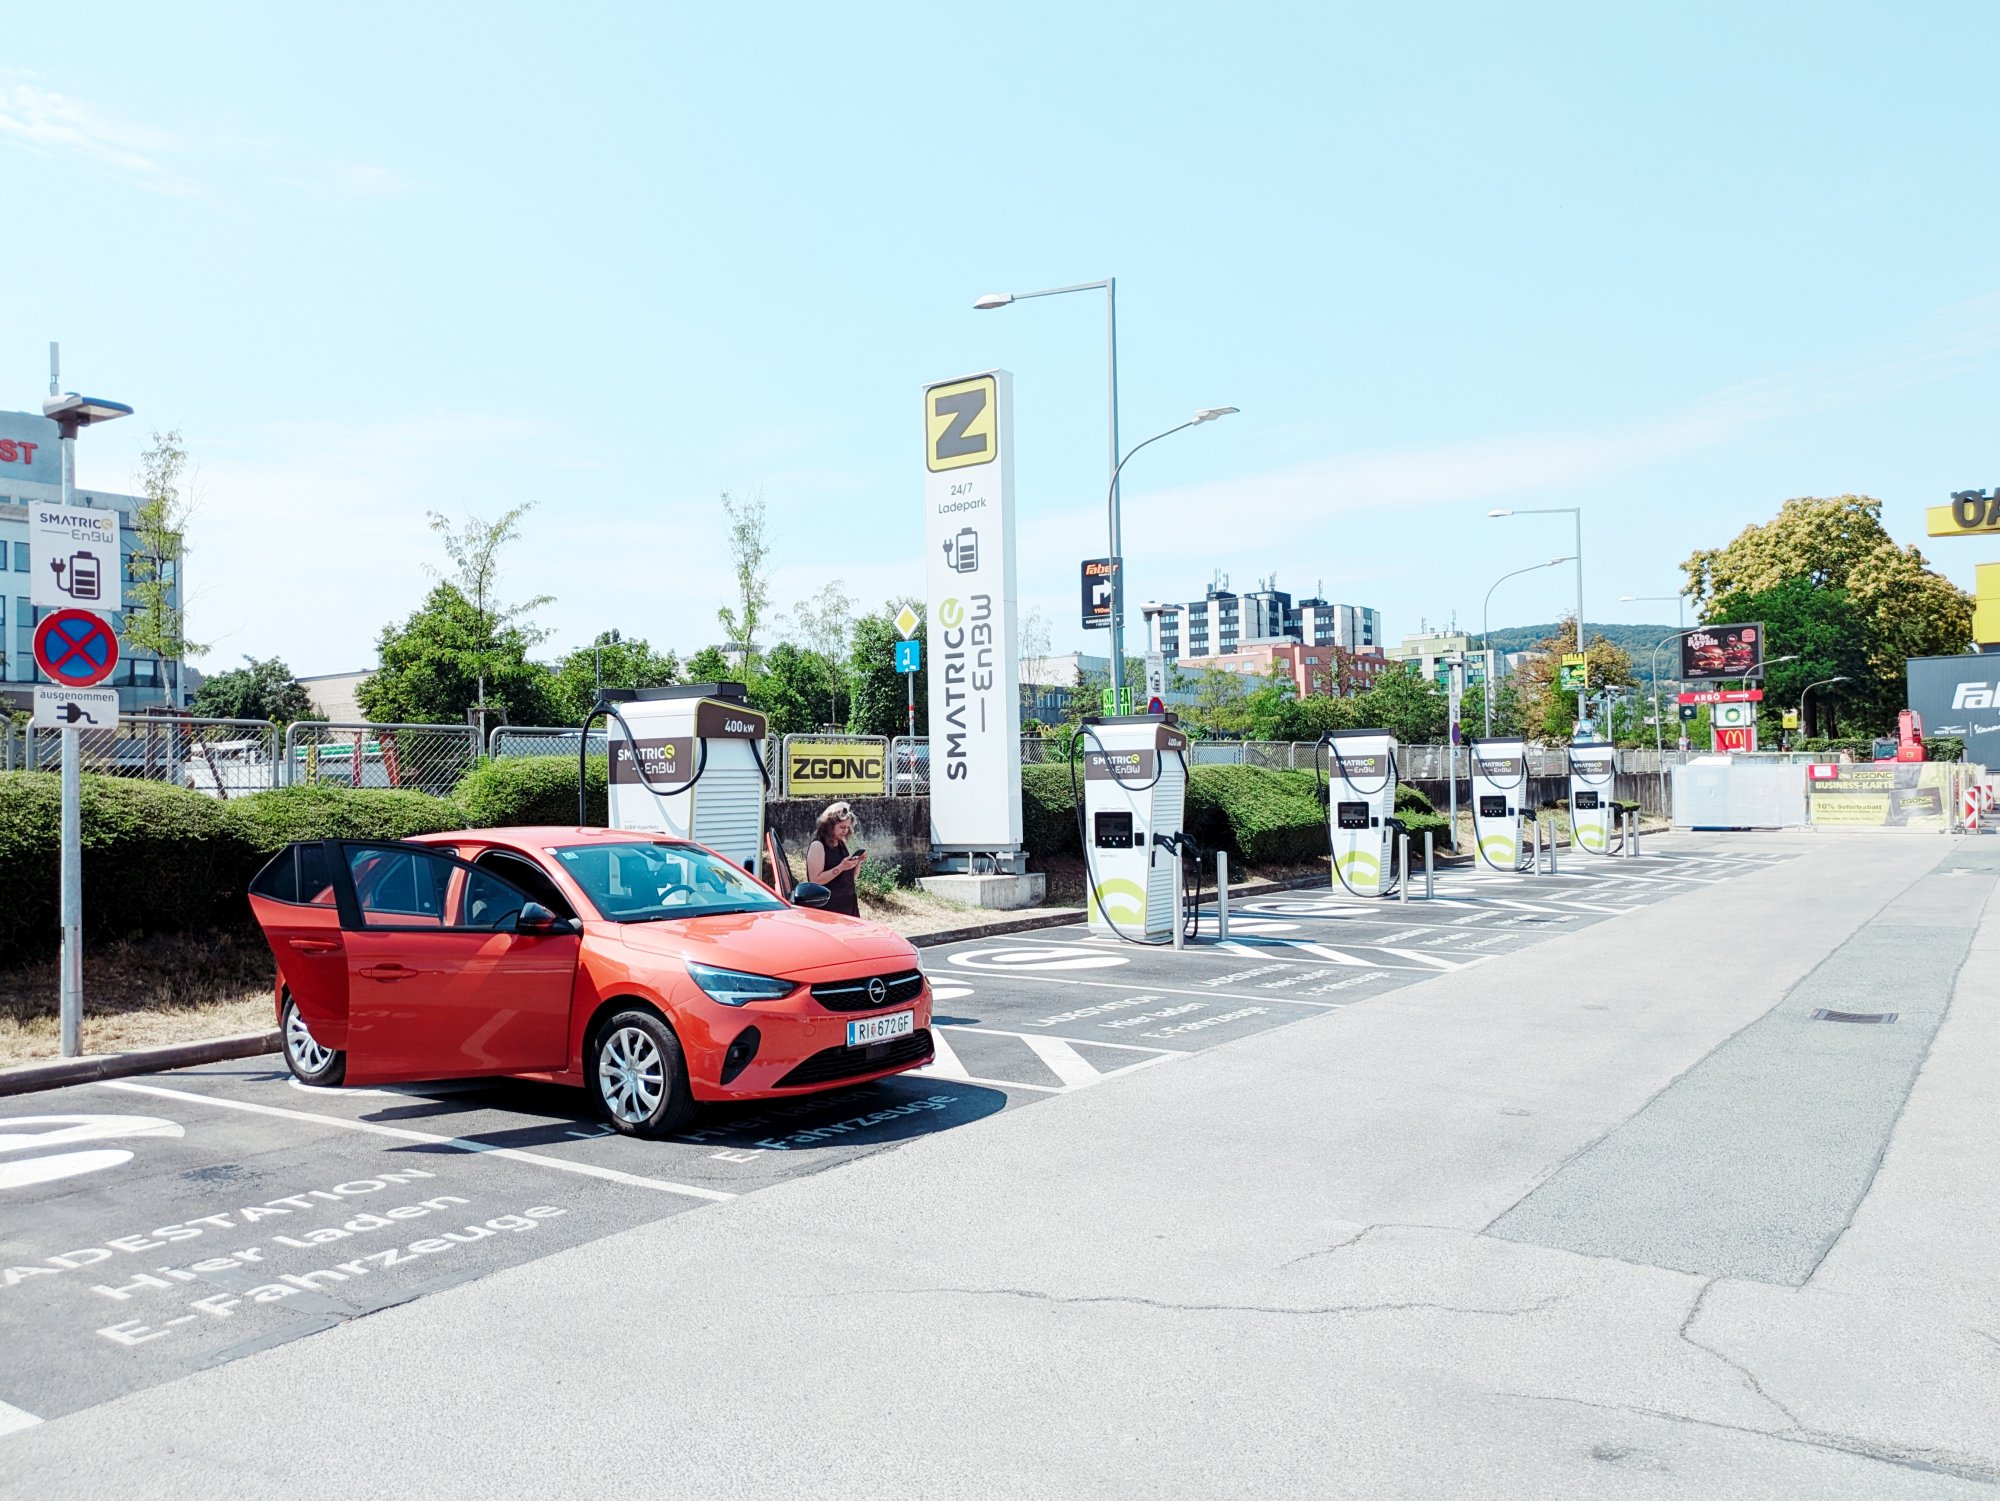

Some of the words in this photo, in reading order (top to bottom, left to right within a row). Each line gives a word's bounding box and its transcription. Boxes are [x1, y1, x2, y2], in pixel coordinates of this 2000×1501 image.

[935, 388, 988, 460] Z
[951, 482, 973, 496] 24/7
[938, 496, 986, 514] Ladepark
[1687, 637, 1719, 650] Royals
[1561, 652, 1584, 661] BILLA
[40, 691, 114, 702] ausgenommen
[1694, 692, 1720, 702] ARBÖ
[1951, 681, 2000, 709] Fa
[644, 762, 676, 775] EnBW
[793, 758, 881, 780] ZGONC
[1115, 765, 1140, 774] EnBW
[1815, 781, 1895, 789] BUSINESS-KARTE
[0, 1168, 437, 1288] ADESTATION
[89, 1247, 265, 1300] Hier
